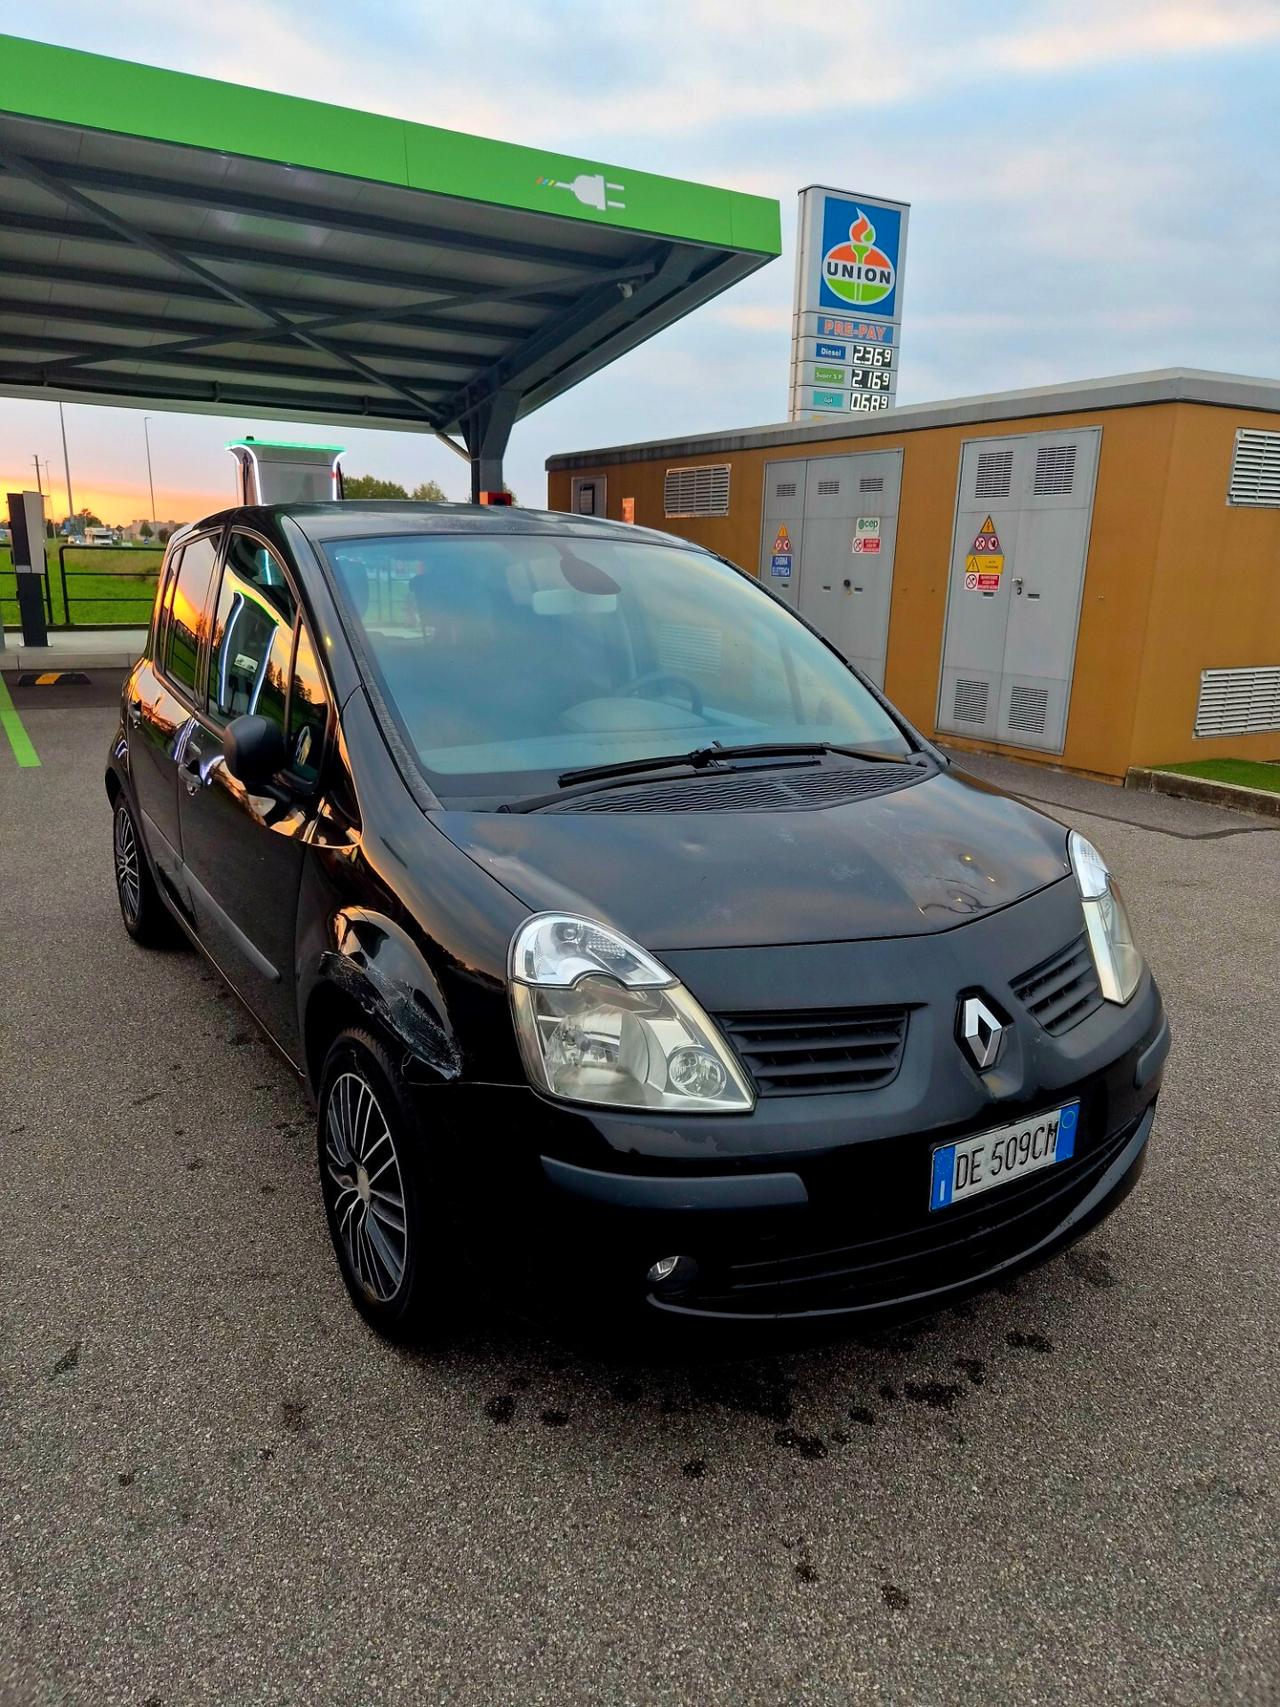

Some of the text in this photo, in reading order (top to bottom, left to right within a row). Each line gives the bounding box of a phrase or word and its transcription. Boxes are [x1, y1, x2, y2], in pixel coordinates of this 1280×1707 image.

[826, 261, 891, 284] UNION
[824, 319, 886, 341] PRE-PAY
[821, 347, 842, 356] Diesel
[955, 1146, 985, 1191] DE
[990, 1120, 1060, 1176] 509CM
